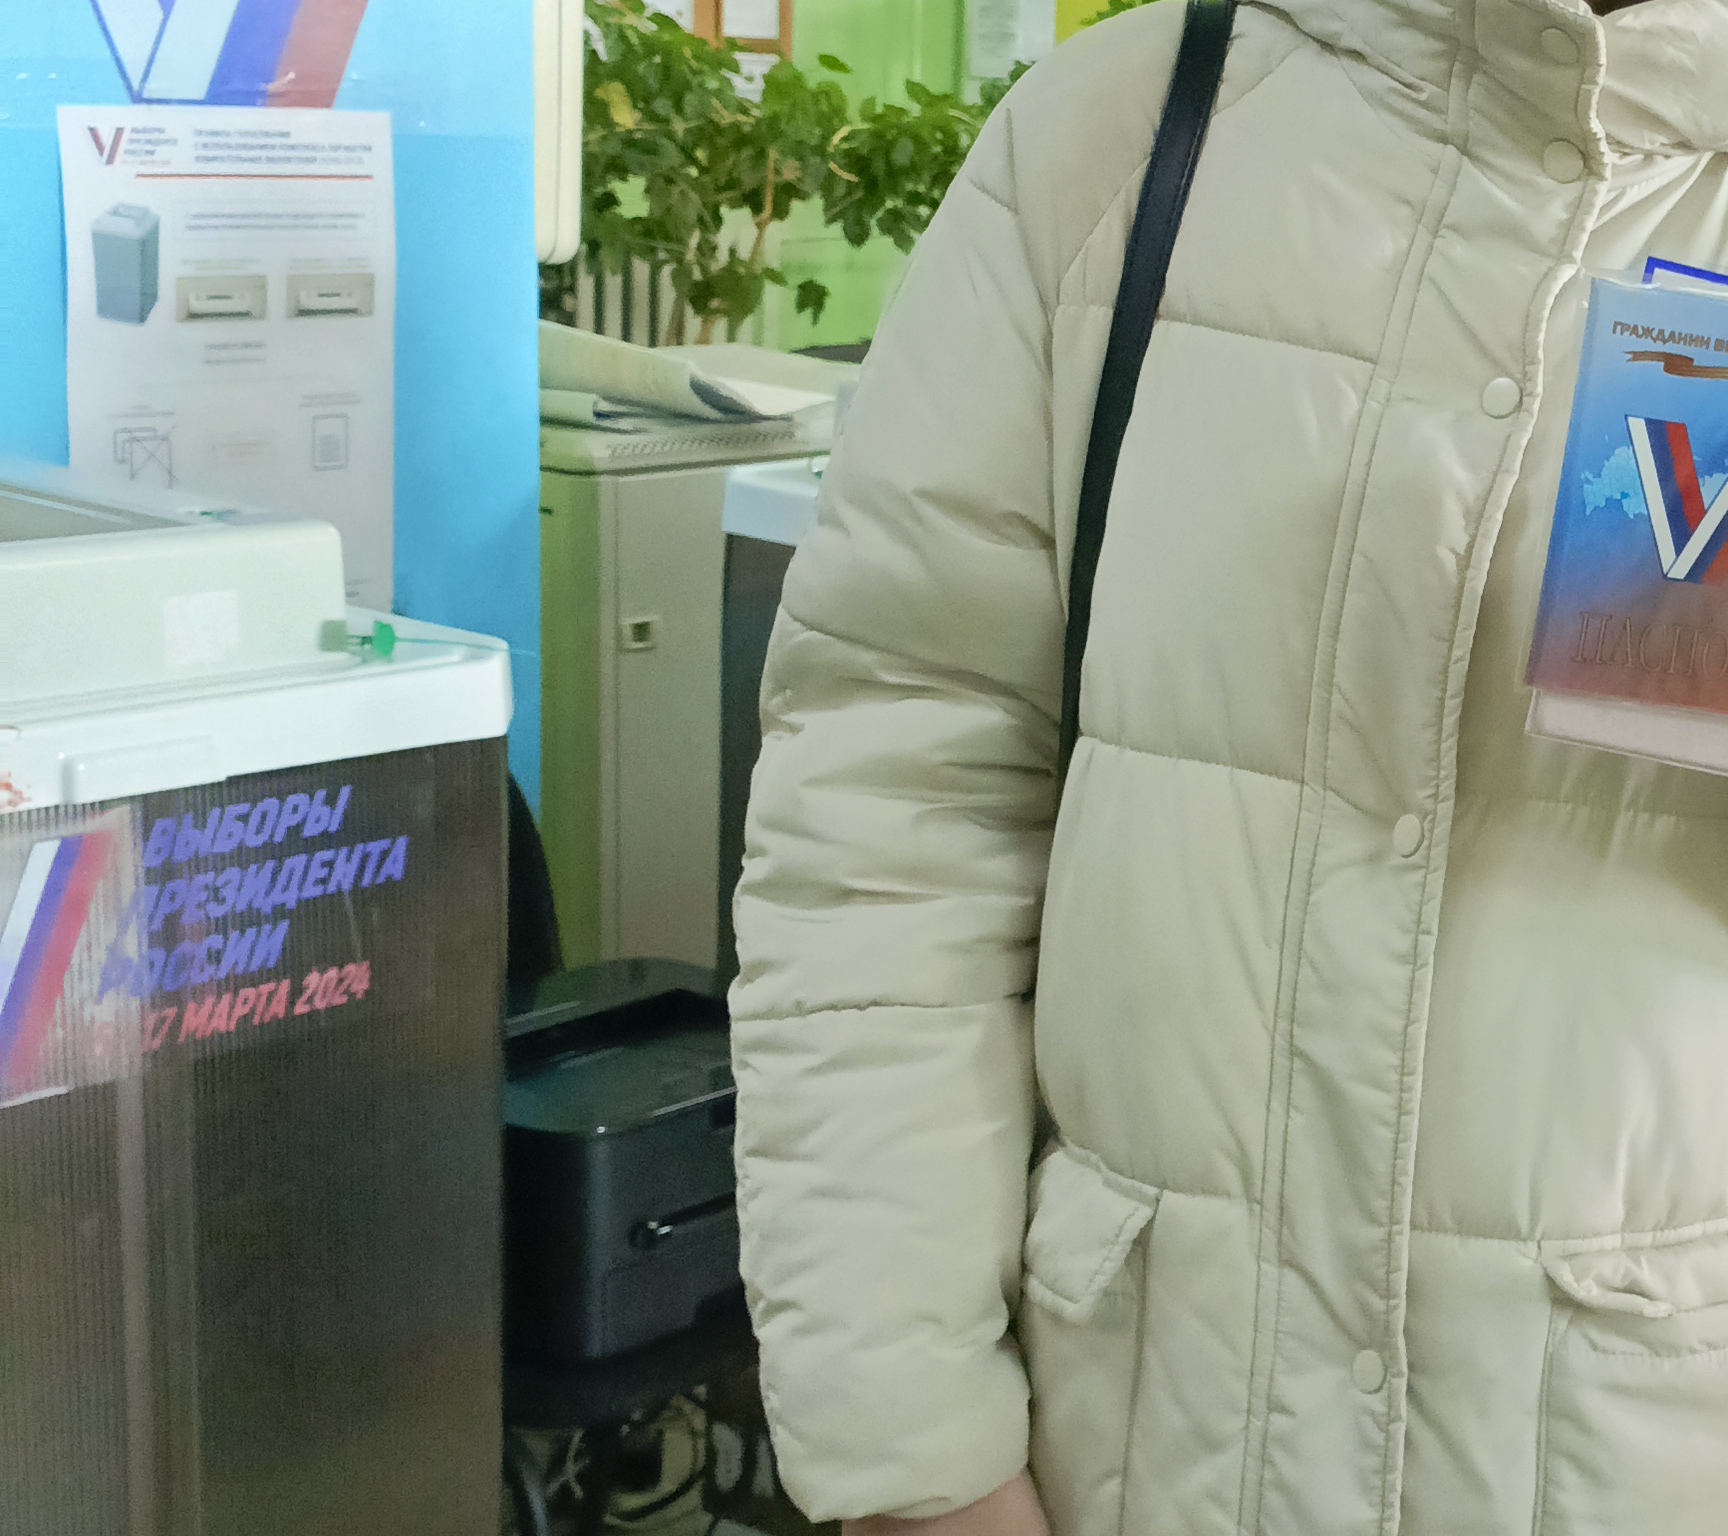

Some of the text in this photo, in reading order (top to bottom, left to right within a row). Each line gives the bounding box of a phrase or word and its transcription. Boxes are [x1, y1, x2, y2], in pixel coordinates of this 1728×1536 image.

[1611, 320, 1711, 351] ГРАЖДАНИН
[142, 784, 352, 868] ВЫБОРЫ
[178, 978, 292, 1047] МАРТА
[294, 961, 371, 1016] 2024
